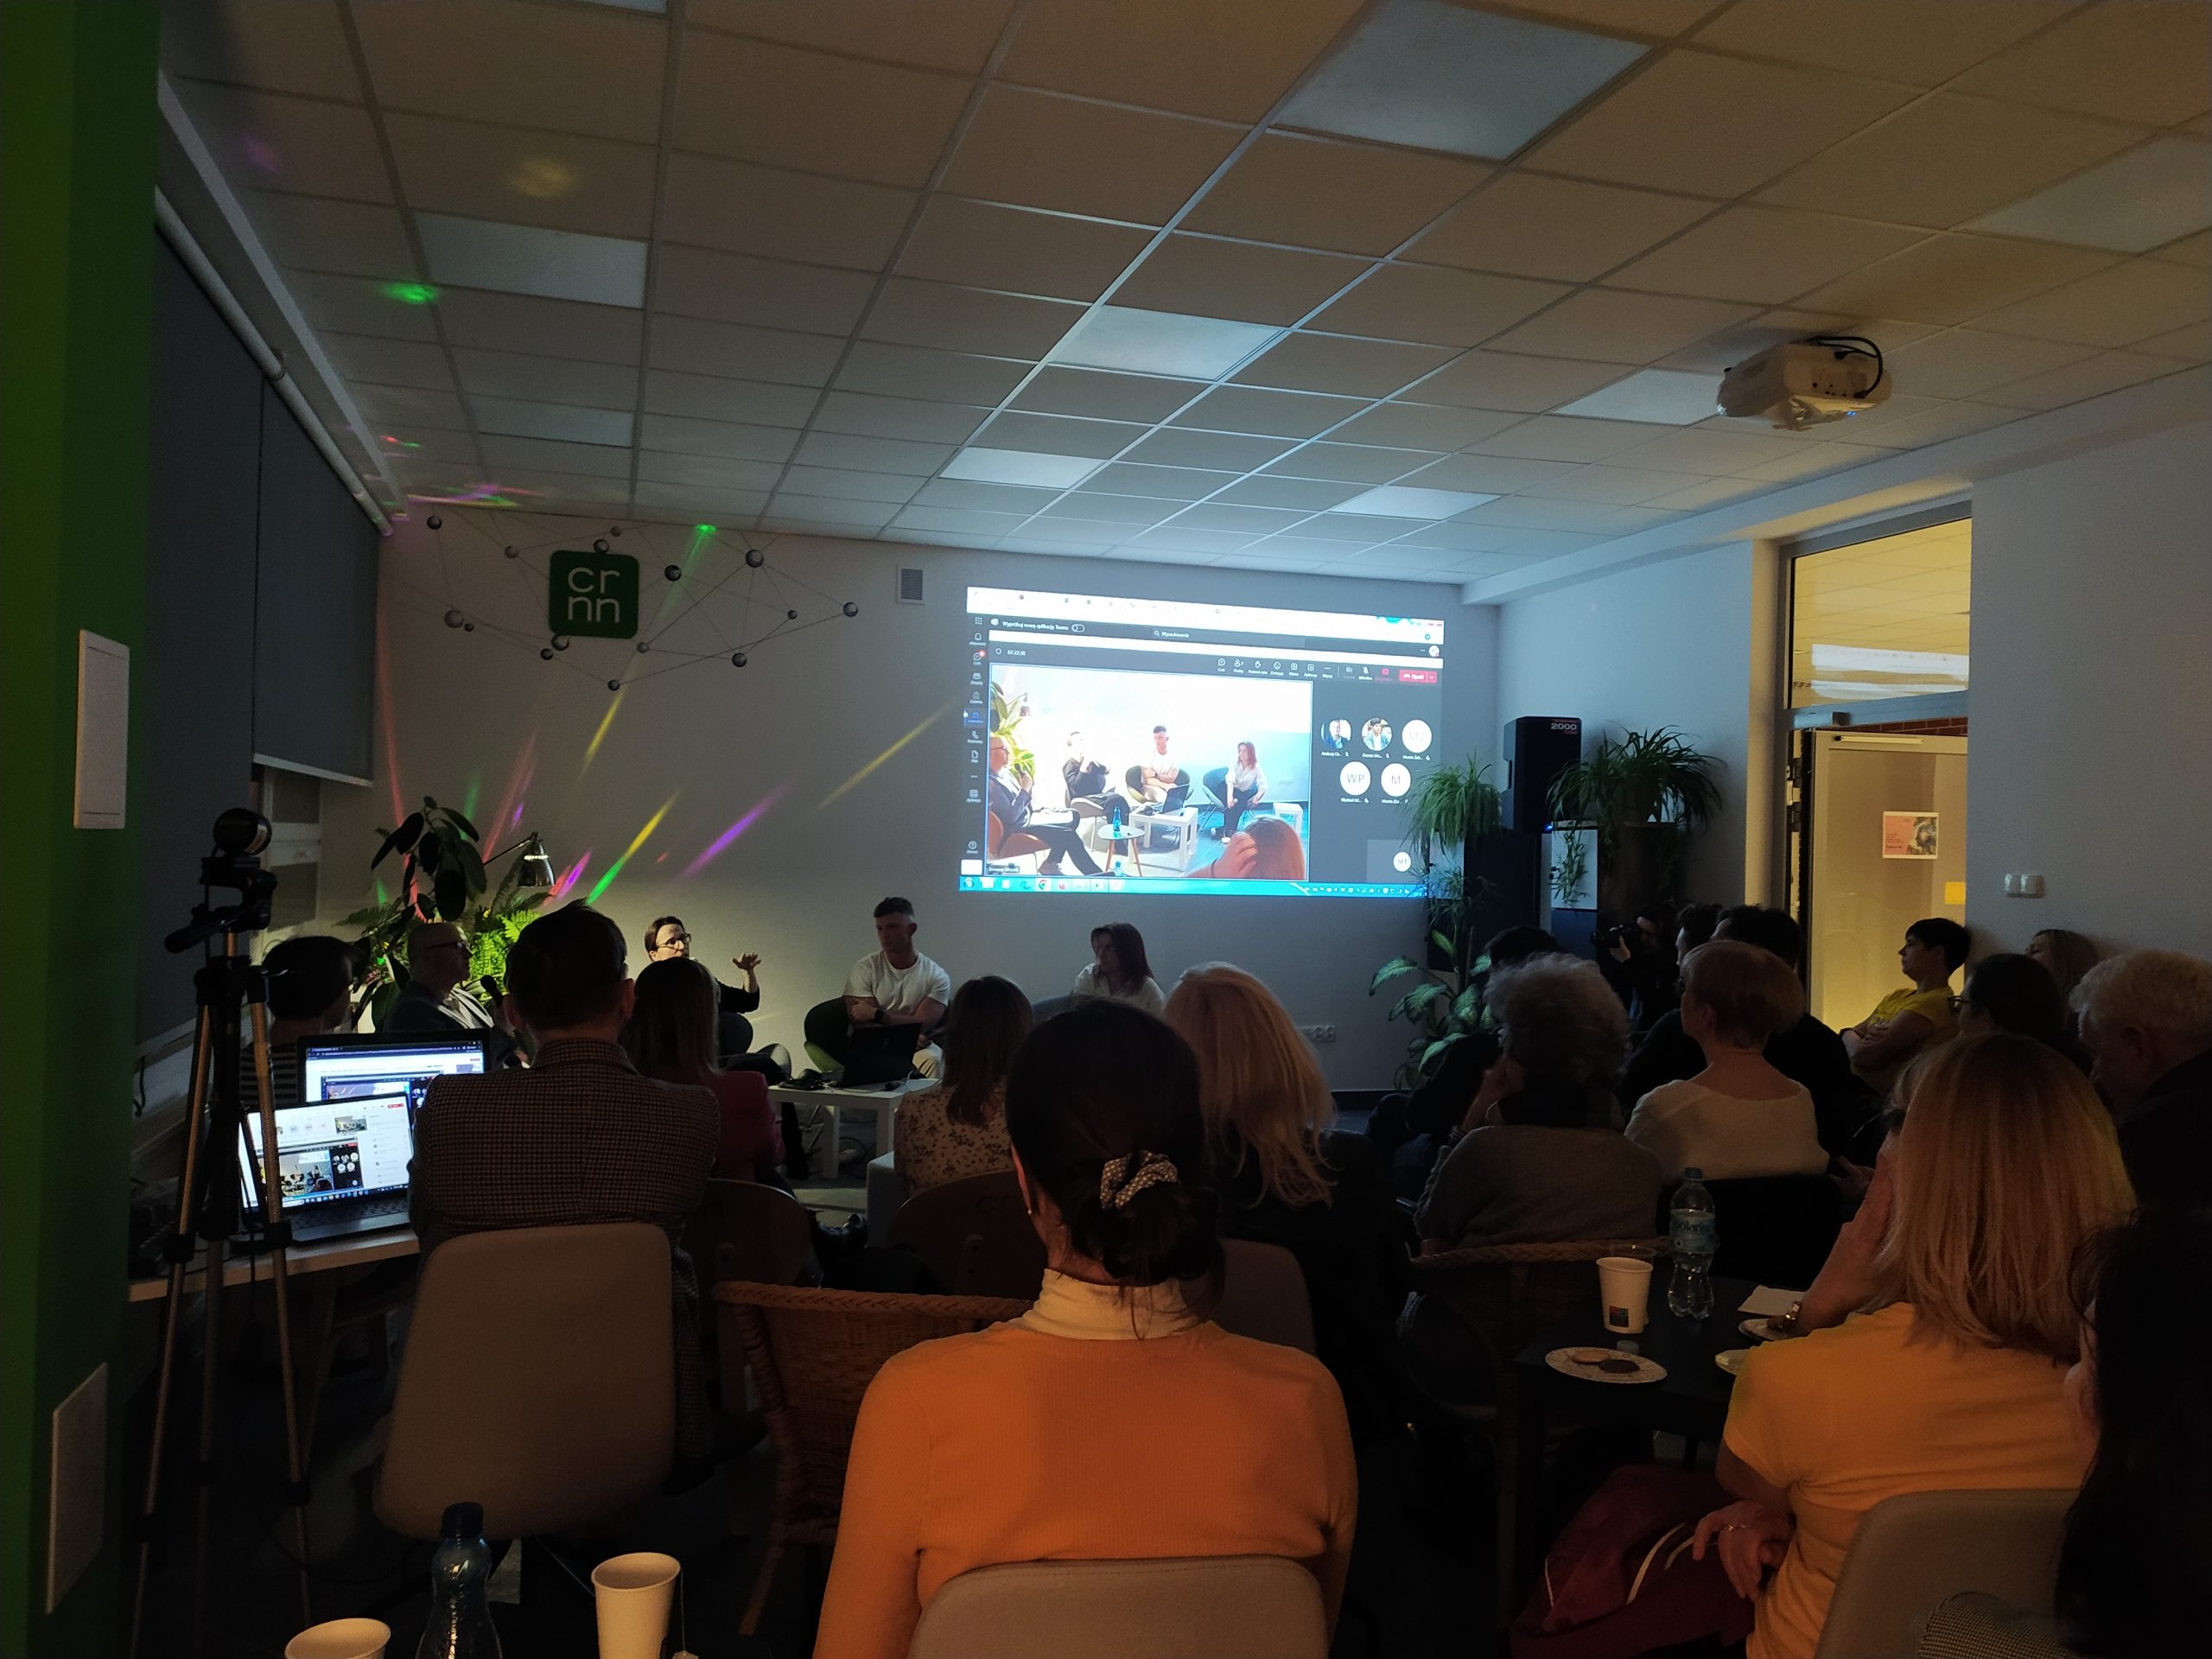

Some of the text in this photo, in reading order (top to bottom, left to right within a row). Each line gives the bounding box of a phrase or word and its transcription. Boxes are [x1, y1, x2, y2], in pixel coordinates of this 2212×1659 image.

[568, 566, 620, 594] cr
[567, 596, 620, 623] nn
[1550, 722, 1577, 731] 2000
[1346, 773, 1364, 784] WP
[1391, 775, 1401, 785] M
